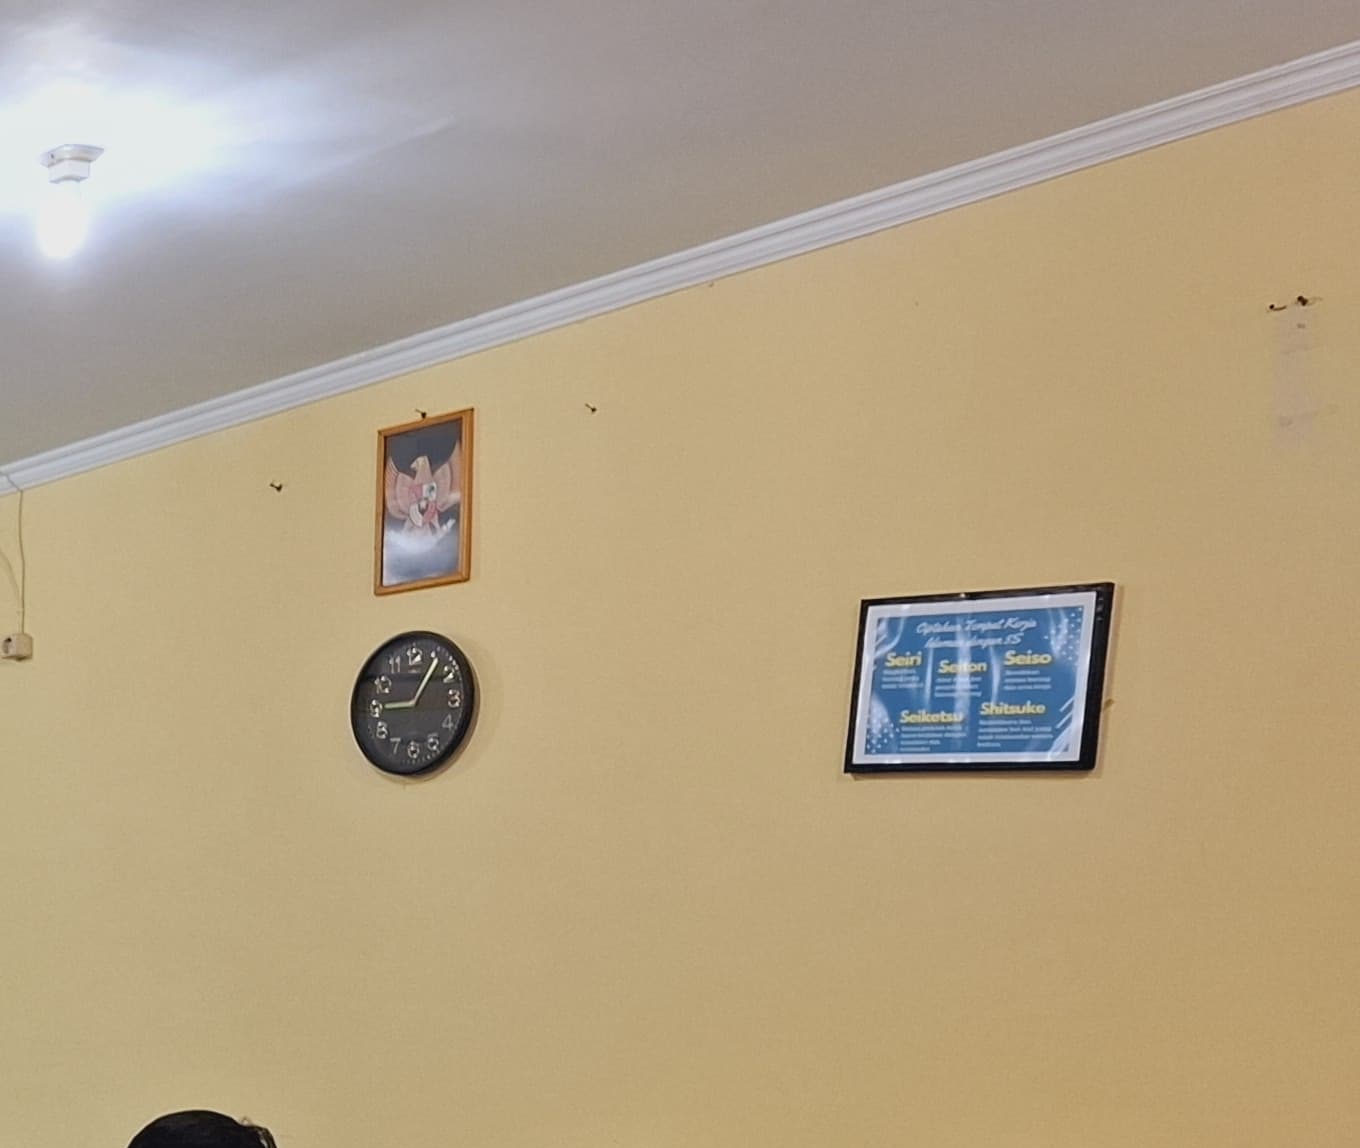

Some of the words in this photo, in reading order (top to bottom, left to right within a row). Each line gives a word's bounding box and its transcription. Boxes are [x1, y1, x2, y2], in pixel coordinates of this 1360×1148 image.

[389, 655, 401, 674] 11
[885, 651, 923, 667] Seiri
[1003, 649, 1052, 666] Seiso
[980, 701, 1046, 715] Shitsuke
[900, 710, 965, 724] Seiketsu
[390, 737, 401, 755] 7
